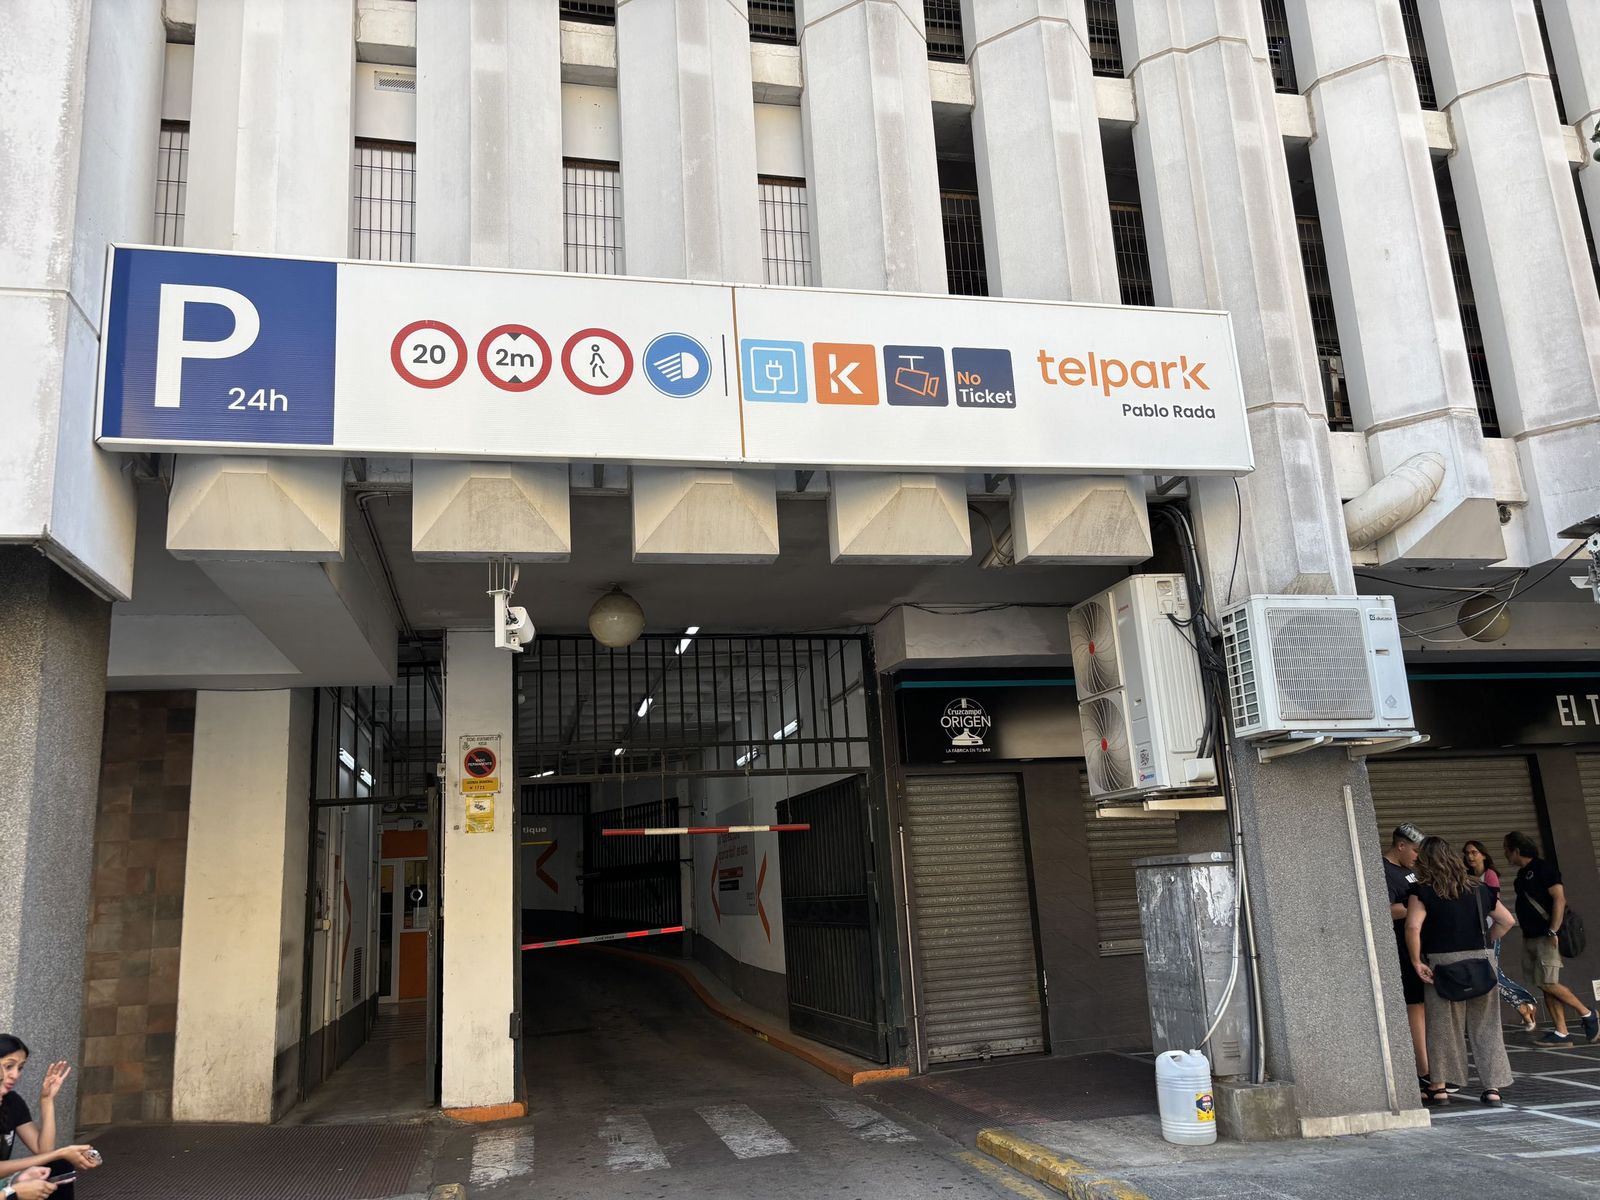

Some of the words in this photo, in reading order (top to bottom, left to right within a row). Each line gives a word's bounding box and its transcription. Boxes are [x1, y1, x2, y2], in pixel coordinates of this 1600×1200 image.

[154, 283, 260, 408] P
[412, 343, 446, 365] 20
[495, 348, 534, 368] 2m
[957, 371, 981, 386] No
[1036, 349, 1211, 397] telpark
[227, 387, 288, 412] 24h
[959, 388, 1013, 404] Ticket
[1122, 403, 1169, 418] Pablo
[1173, 405, 1216, 419] Rada
[947, 708, 982, 716] Cruzcampo
[1556, 694, 1586, 726] EL
[1585, 694, 1600, 726] T
[940, 715, 992, 728] ORIGEN
